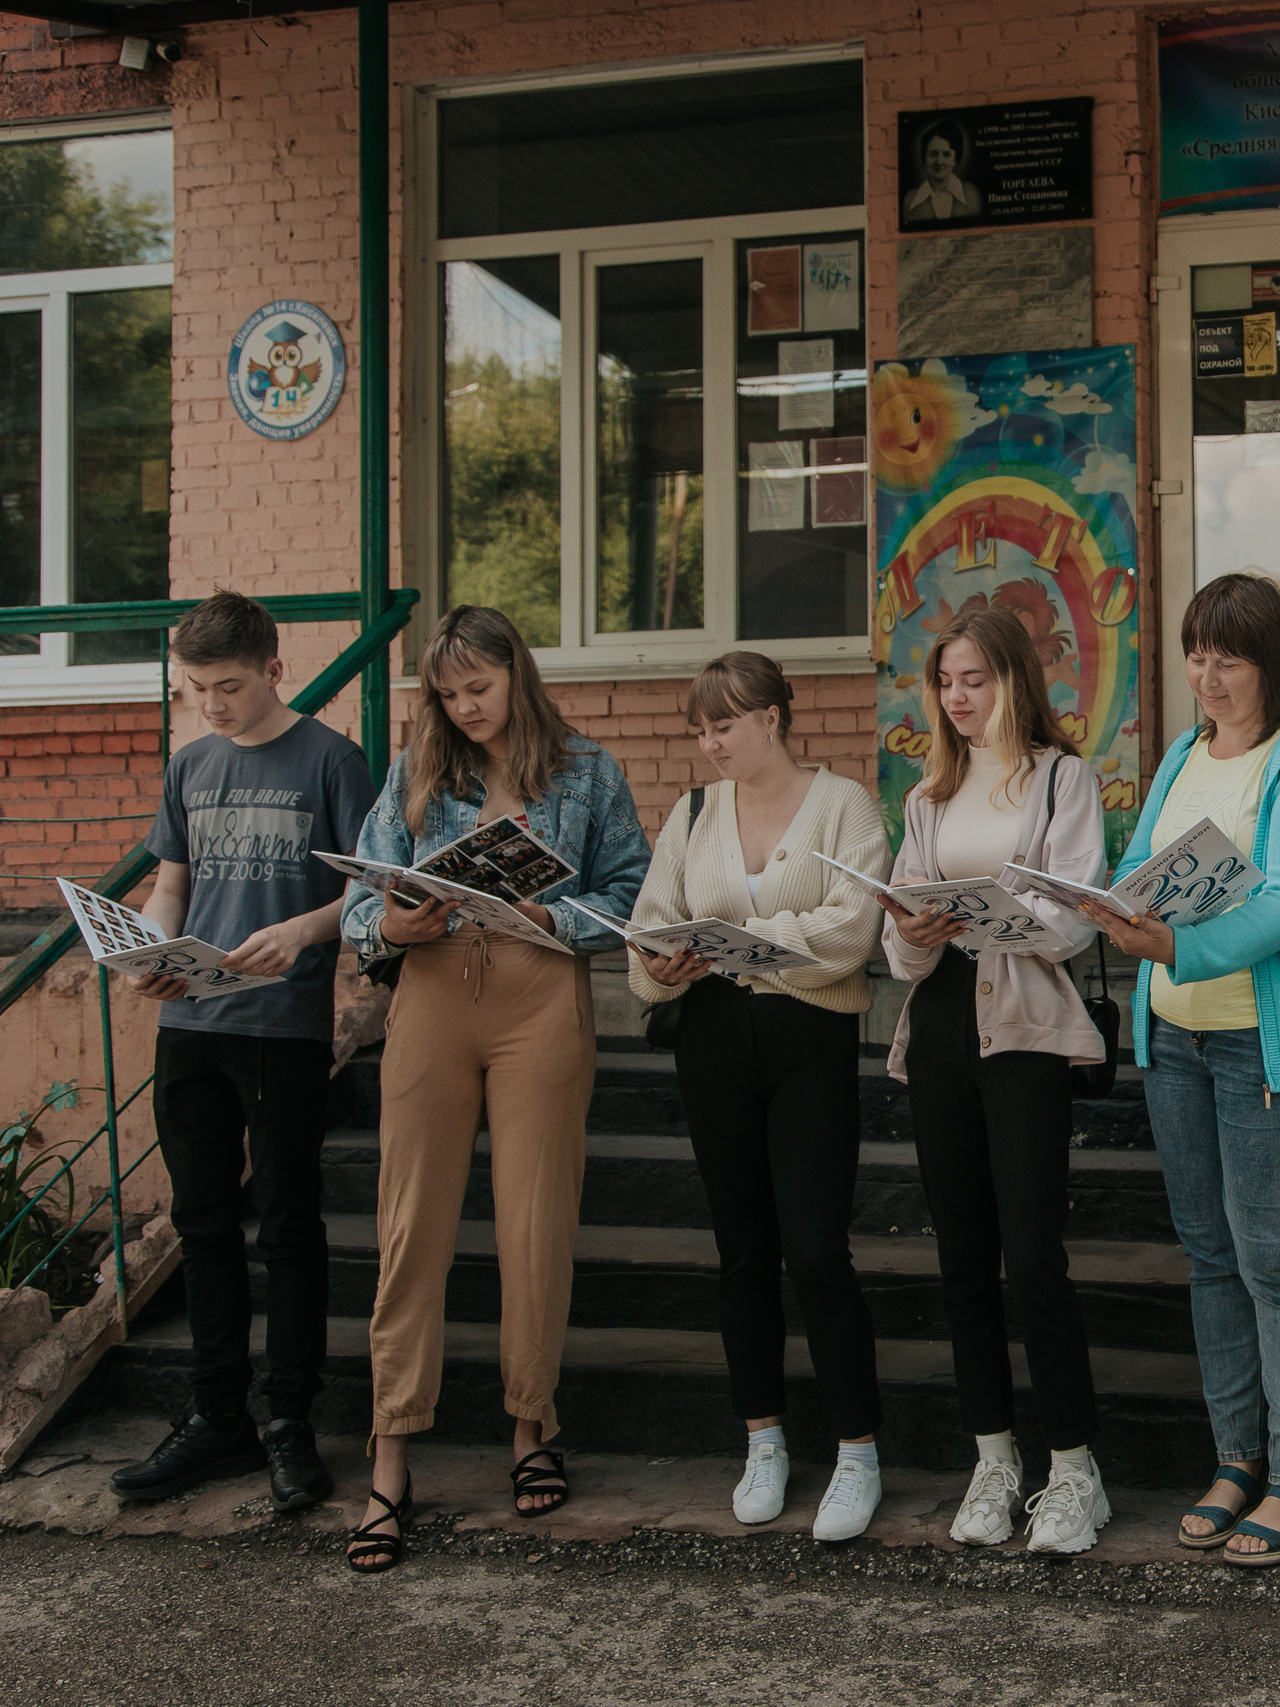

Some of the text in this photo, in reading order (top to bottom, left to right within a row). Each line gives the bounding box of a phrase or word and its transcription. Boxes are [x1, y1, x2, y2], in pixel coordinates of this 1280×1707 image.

[1181, 136, 1277, 159] «Средняя
[1001, 176, 1056, 190] ТОРГАЕВА
[233, 312, 262, 348] Школа
[1198, 326, 1233, 337] ОБЪЕКТ
[1199, 343, 1220, 353] ПОД
[1200, 356, 1243, 370] ОХРАНОЙ
[292, 372, 341, 438] уверенность
[876, 500, 1137, 634] ЛЕТО
[188, 788, 304, 808] ONLY FOR BRAVE
[1125, 825, 1211, 892] ВЫПУСКНОЙ АЛЬБОМ
[910, 883, 996, 897] ВЫПУСКНОЙ АЛЬБОМ
